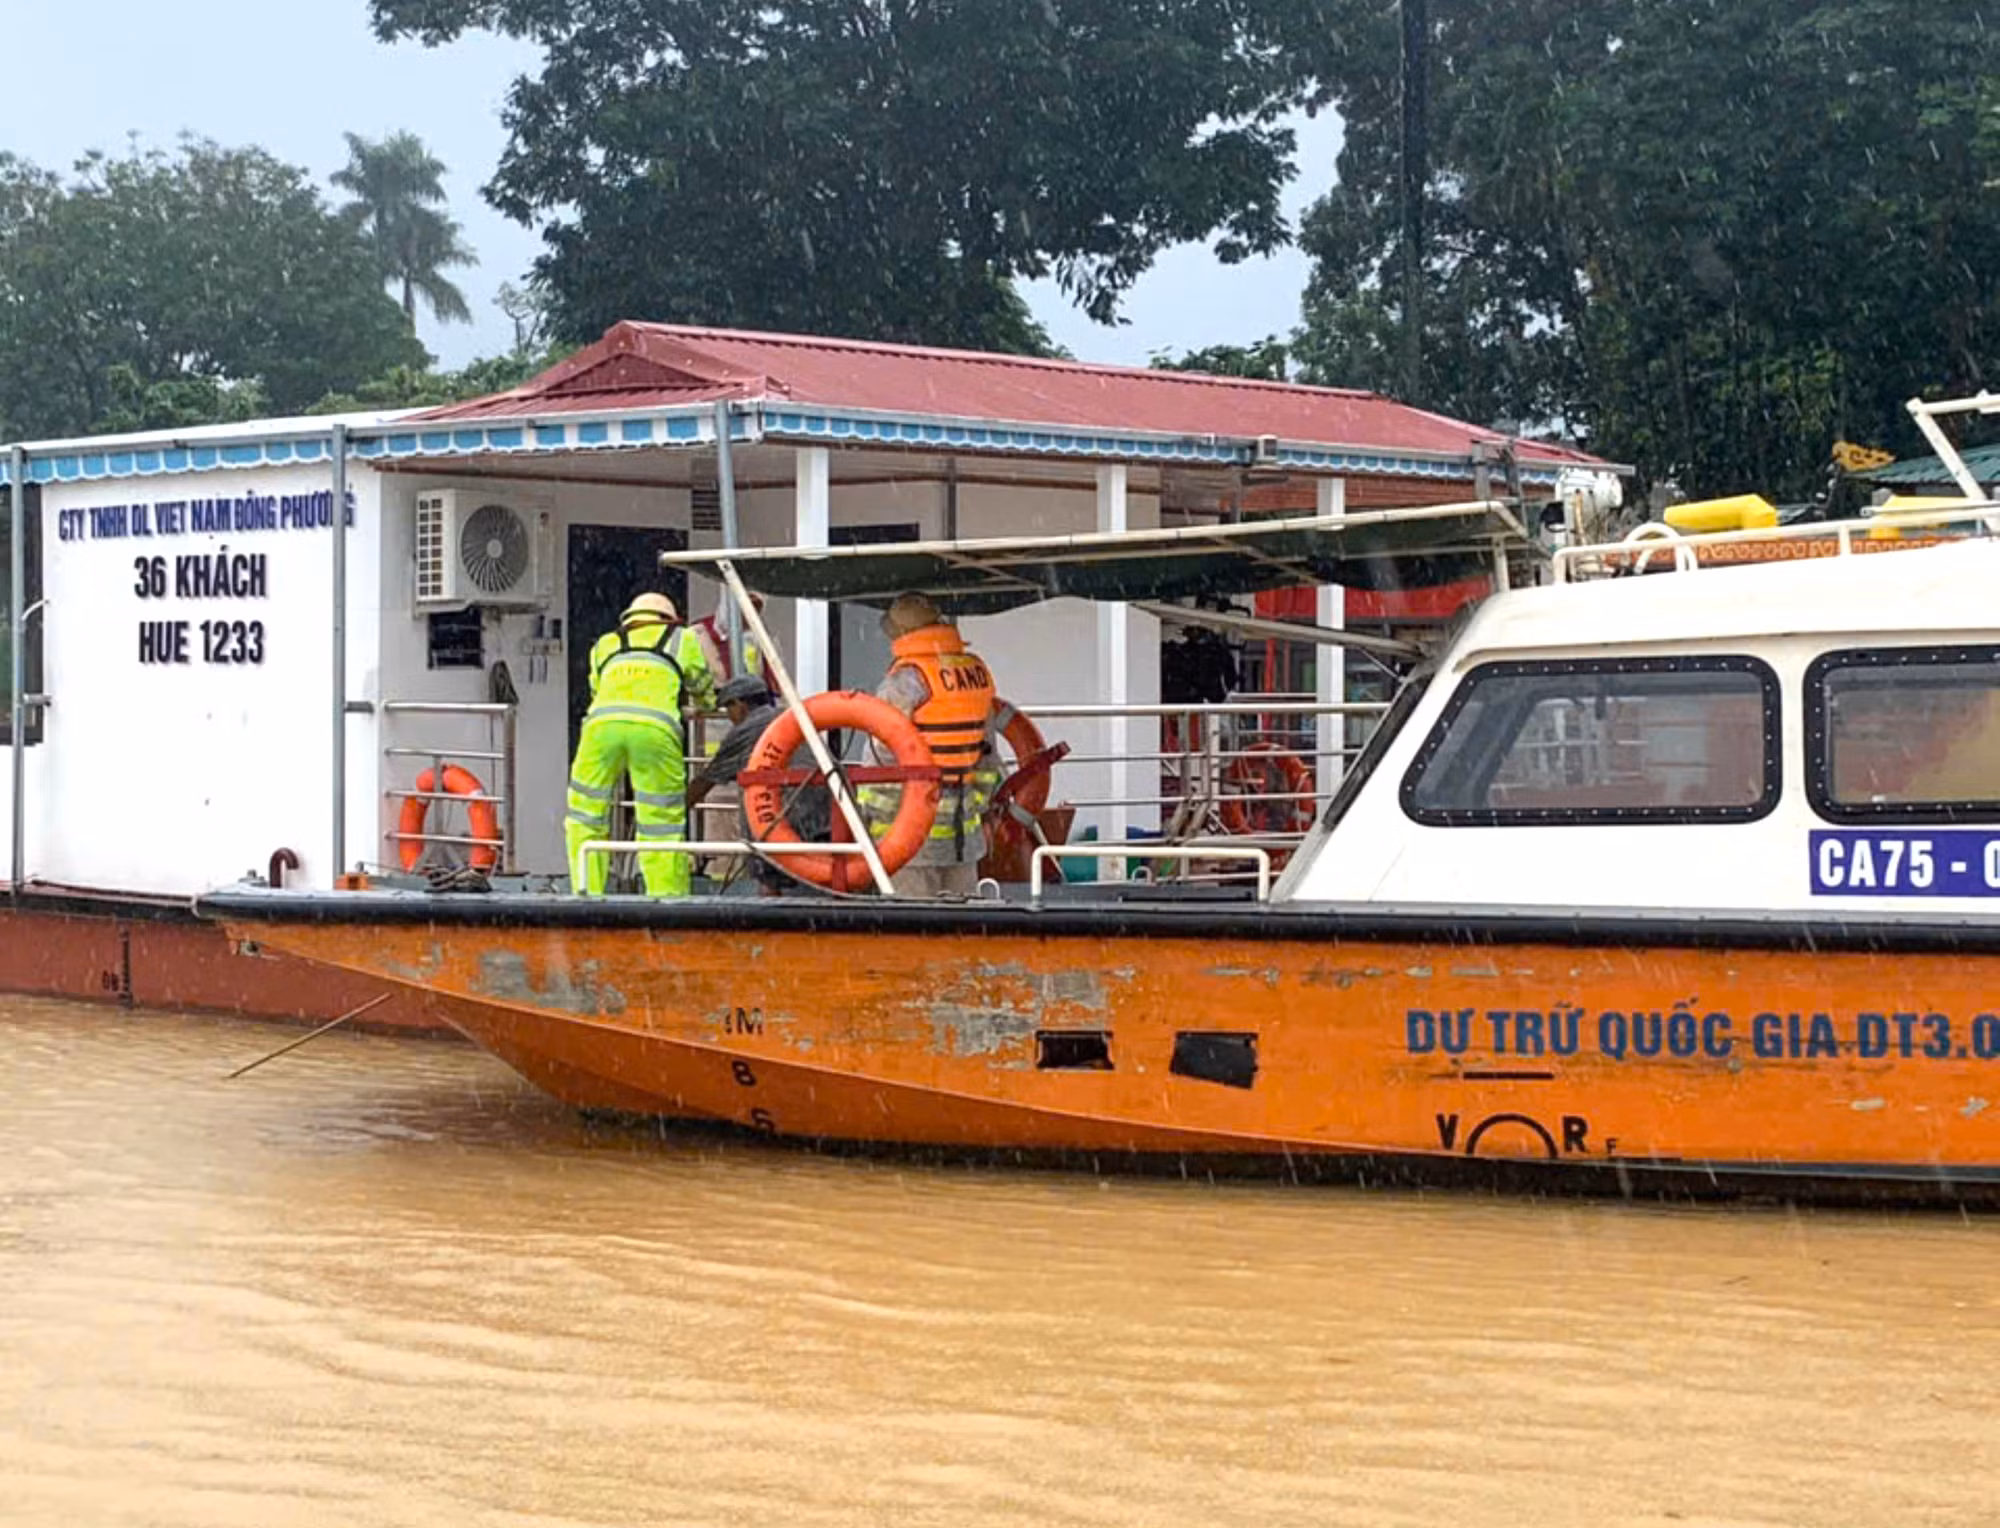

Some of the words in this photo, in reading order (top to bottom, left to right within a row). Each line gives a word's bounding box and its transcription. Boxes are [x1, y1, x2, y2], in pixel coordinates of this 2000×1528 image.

[59, 508, 85, 541] CTY
[89, 504, 128, 539] TNHH
[134, 555, 167, 599] 36
[175, 544, 267, 599] KHÁCH
[138, 620, 189, 664] HUE
[199, 619, 264, 664] 1233
[940, 665, 989, 691] CAND
[1819, 839, 1934, 888] CA75
[1486, 1002, 1585, 1056] TRỮ
[1599, 997, 1732, 1061] QUỐC
[1753, 1012, 1839, 1058] GIA
